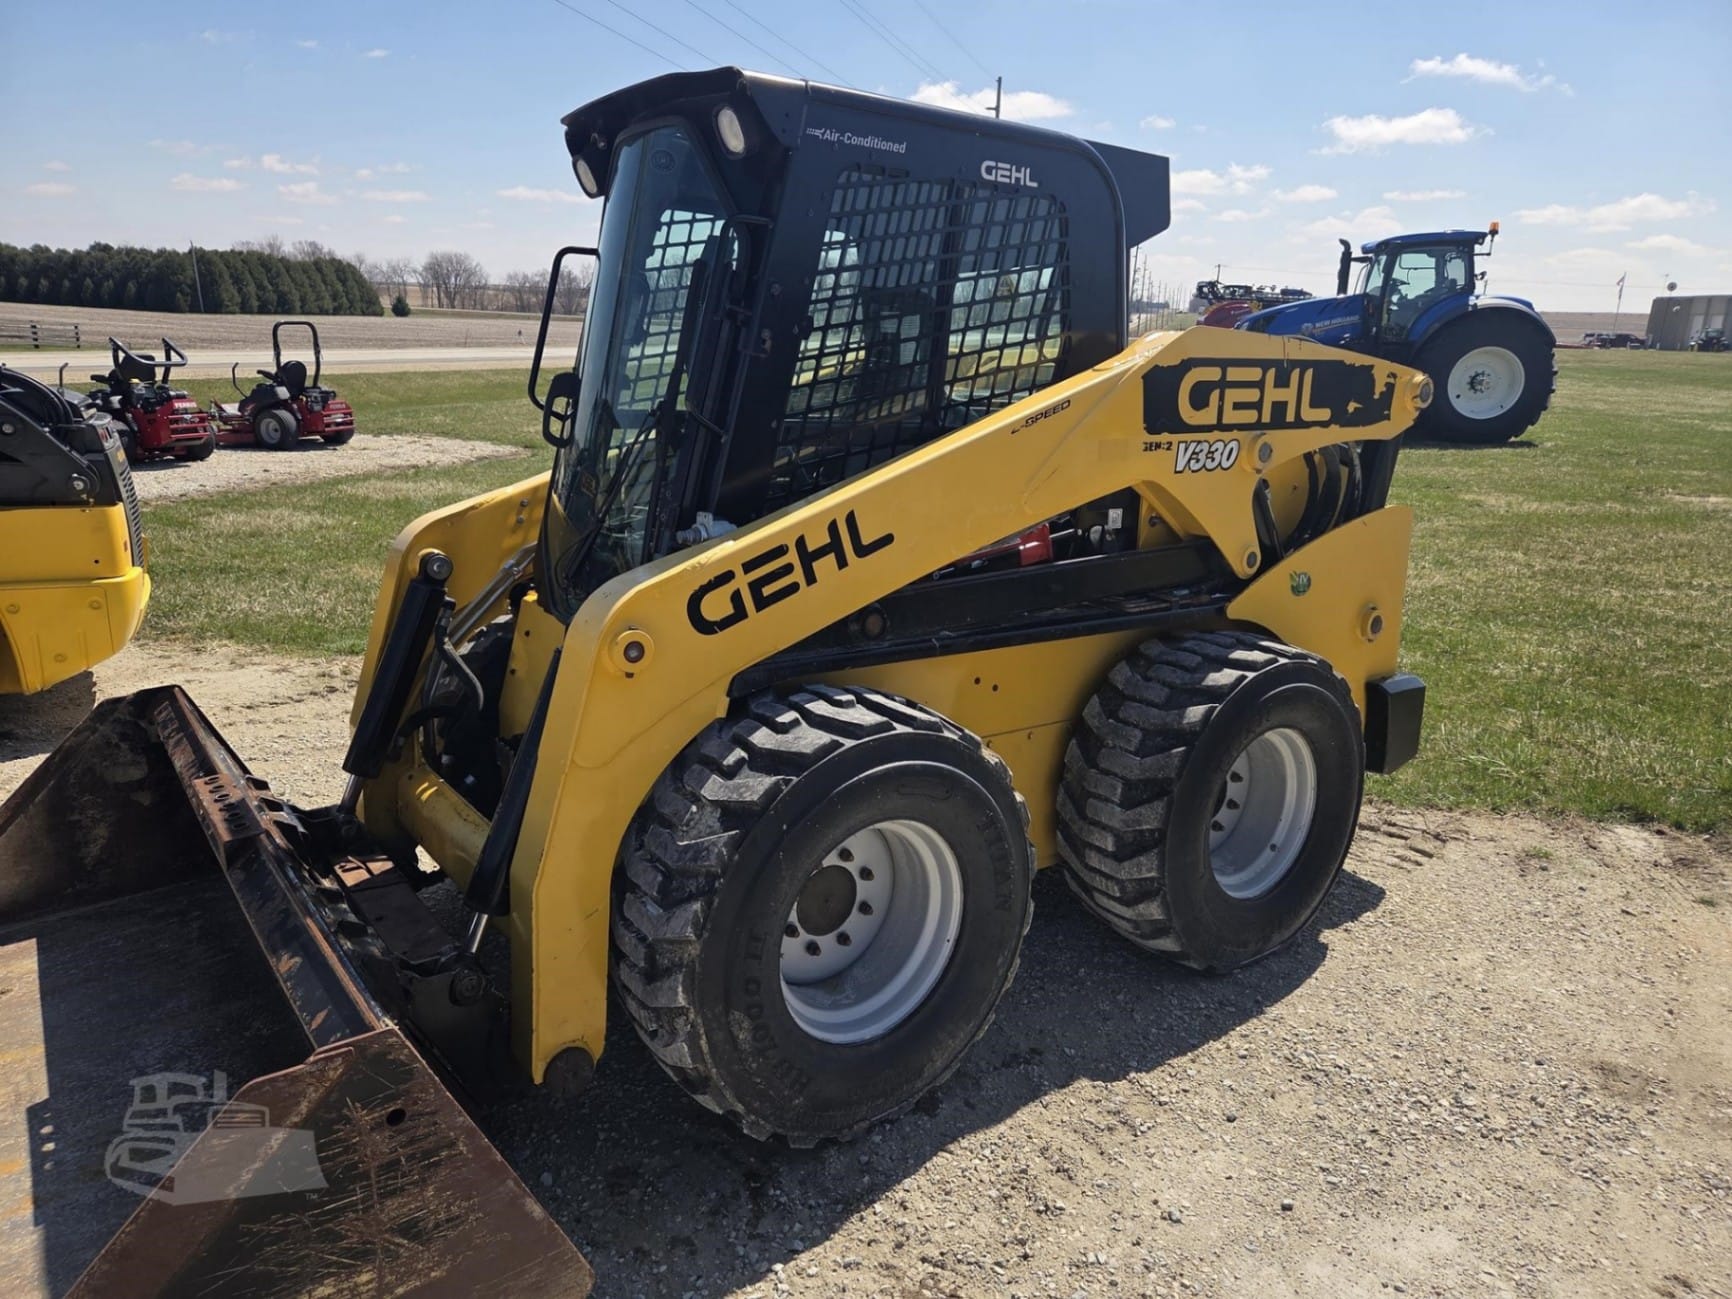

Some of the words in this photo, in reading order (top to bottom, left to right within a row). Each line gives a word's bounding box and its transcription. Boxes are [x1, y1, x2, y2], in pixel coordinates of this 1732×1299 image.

[824, 128, 907, 153] Air-Conditioned
[980, 160, 1039, 188] GEHL
[1178, 367, 1331, 425] GEHL
[1174, 439, 1240, 474] V330
[686, 509, 895, 635] GEHL
